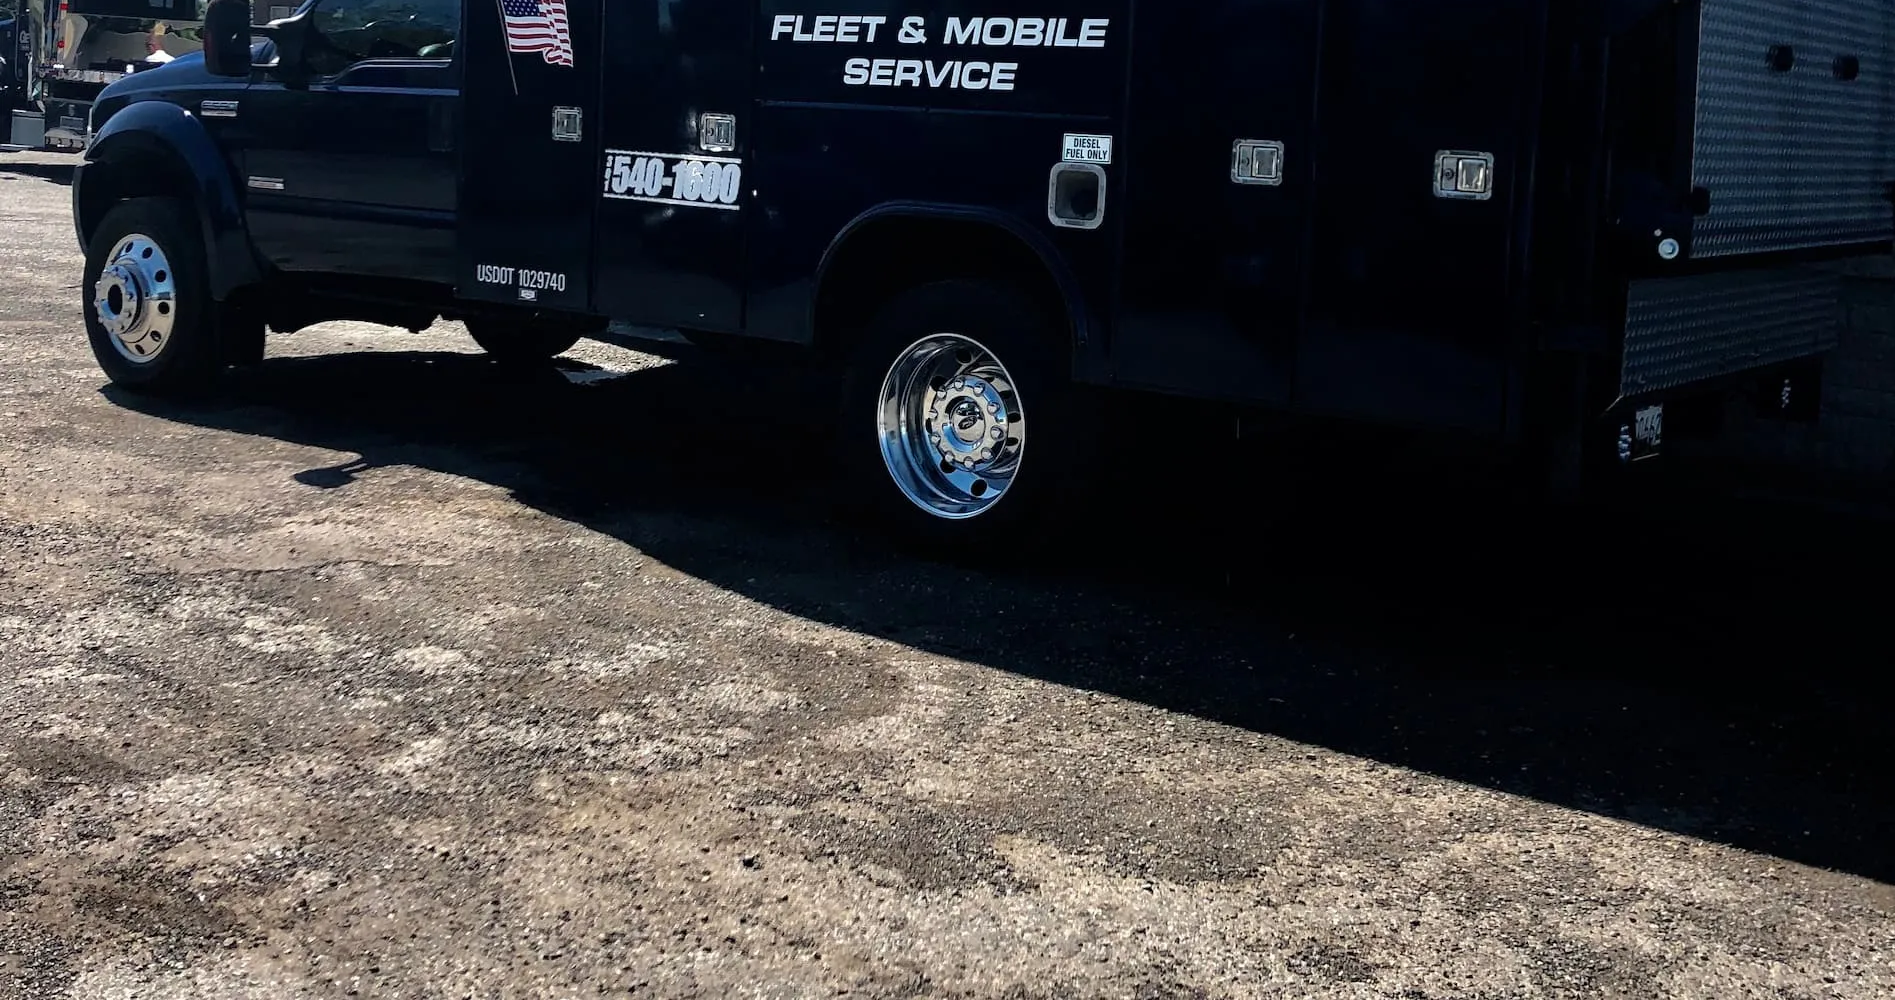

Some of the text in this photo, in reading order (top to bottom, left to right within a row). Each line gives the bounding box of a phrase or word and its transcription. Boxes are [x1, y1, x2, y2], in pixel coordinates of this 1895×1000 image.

[771, 15, 1110, 47] FLEET & MOBILE
[843, 58, 1018, 90] SERVICE
[1065, 148, 1108, 160] FUEL ONLY
[1073, 137, 1101, 149] DIESEL
[477, 264, 566, 292] USDOT 1029740
